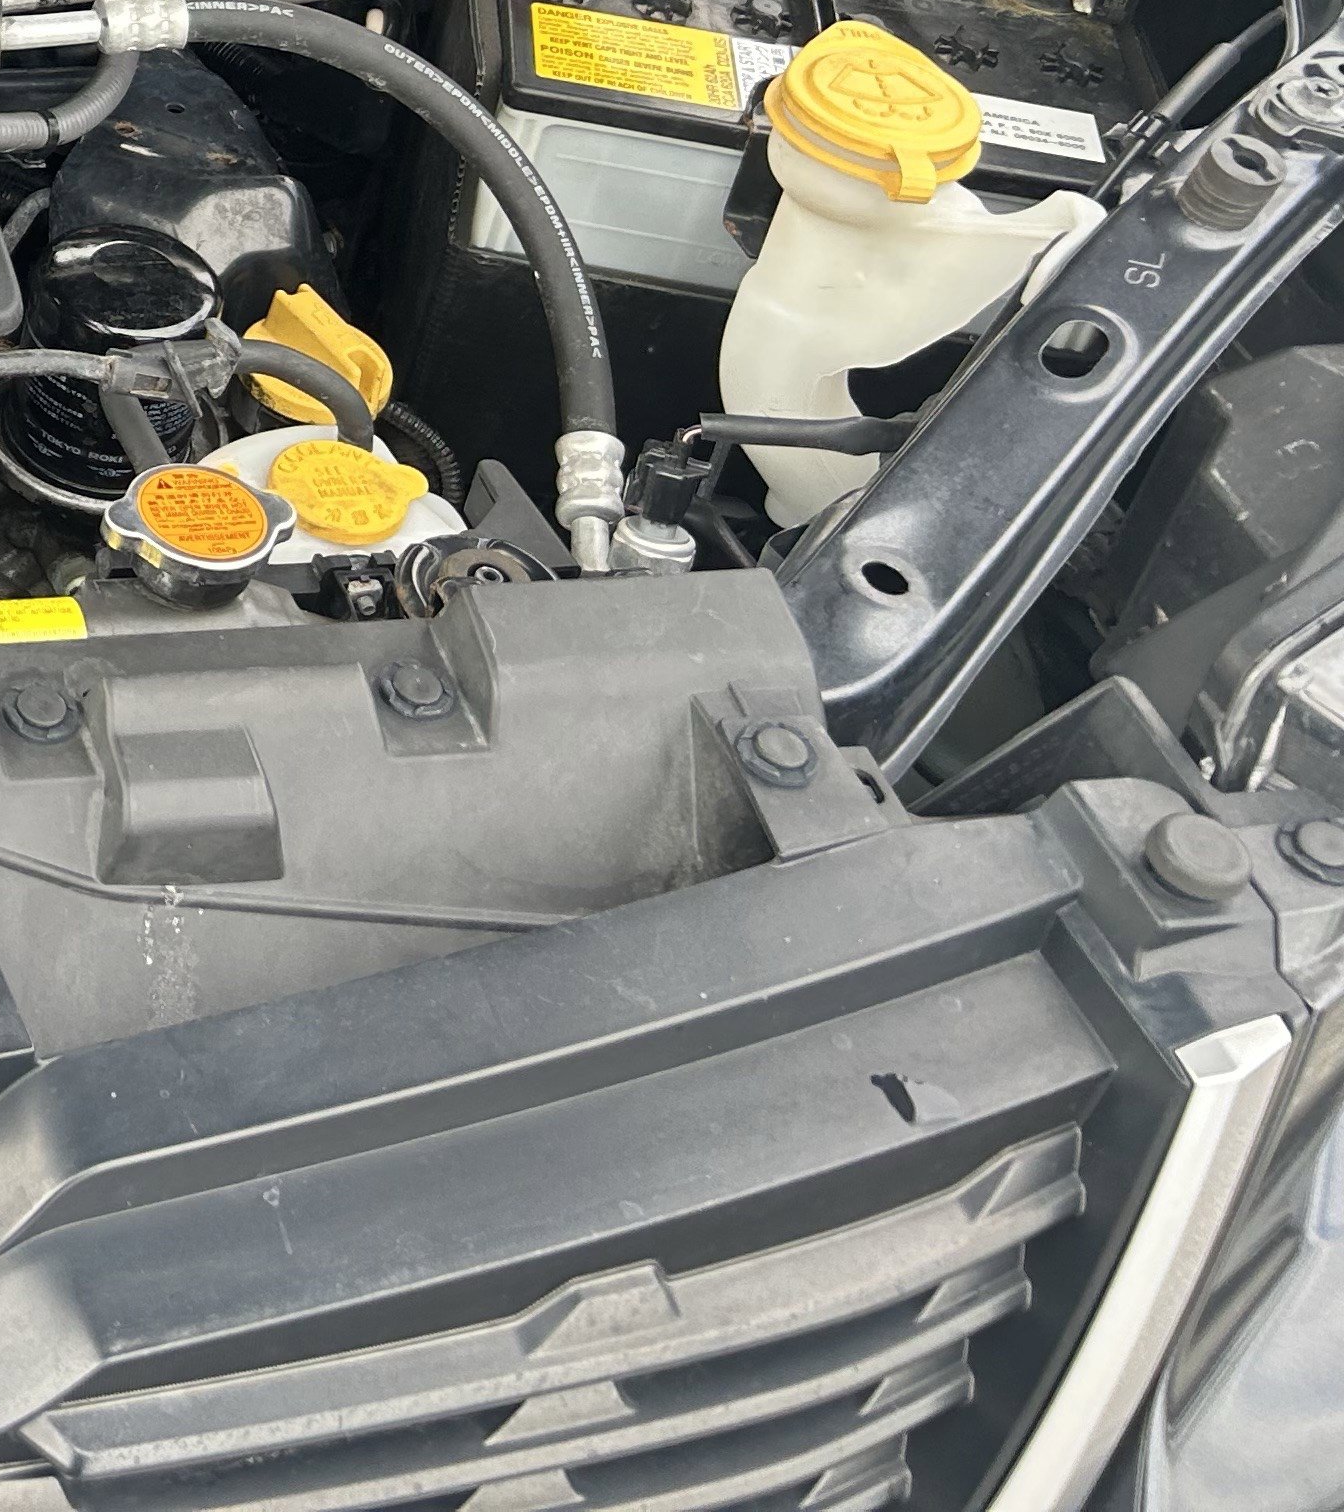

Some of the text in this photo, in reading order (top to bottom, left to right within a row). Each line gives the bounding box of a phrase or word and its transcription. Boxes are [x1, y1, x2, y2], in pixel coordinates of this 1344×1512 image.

[540, 44, 594, 60] POISON
[1124, 252, 1166, 289] SL
[40, 428, 81, 456] TOKYO
